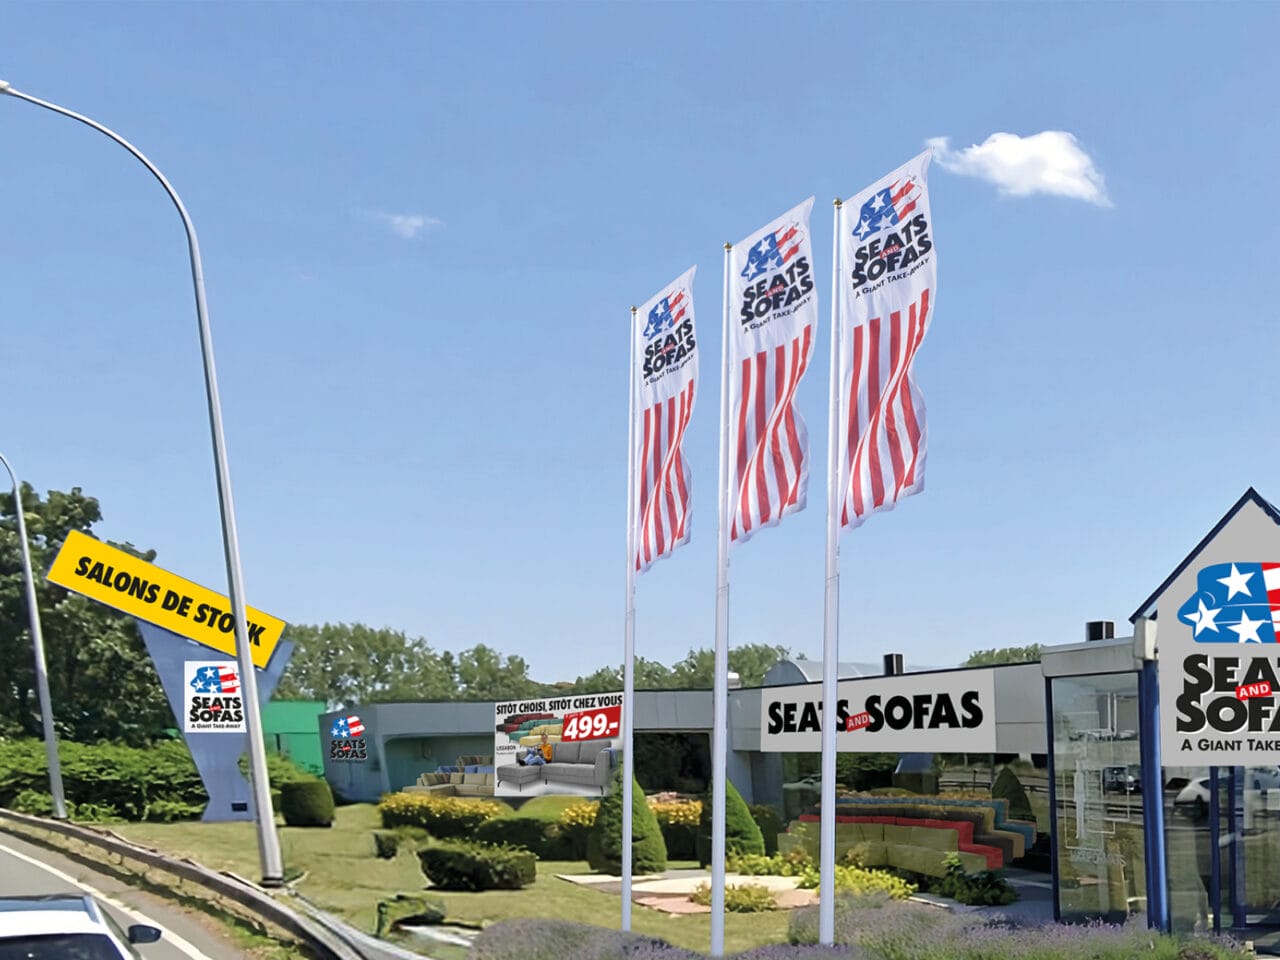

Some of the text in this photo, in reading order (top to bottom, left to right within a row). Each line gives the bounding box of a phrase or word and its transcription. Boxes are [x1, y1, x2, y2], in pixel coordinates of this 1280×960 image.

[855, 213, 928, 264] SEATS
[881, 245, 900, 258] AND
[851, 233, 932, 290] SOFAS
[862, 280, 885, 294] GIANT
[887, 257, 929, 283] TAKE-AWAY
[743, 256, 809, 302] SEATS
[740, 274, 814, 326] SOFAS
[645, 318, 693, 362] SEATS
[643, 334, 695, 379] SOFAS
[74, 556, 266, 647] SALONS DE STOK
[192, 696, 242, 710] SEATS
[519, 701, 547, 713] CHOISI,
[573, 697, 596, 709] CHEZ
[598, 695, 623, 707] VOUS
[1239, 683, 1269, 698] AND
[189, 709, 243, 722] SOFAS
[564, 713, 618, 739] 499.-
[768, 690, 984, 735] SEAS AND SOFAS
[330, 749, 367, 759] SOFAS
[331, 739, 366, 749] SEATS
[1181, 739, 1193, 751] A
[1197, 738, 1243, 752] GIANT
